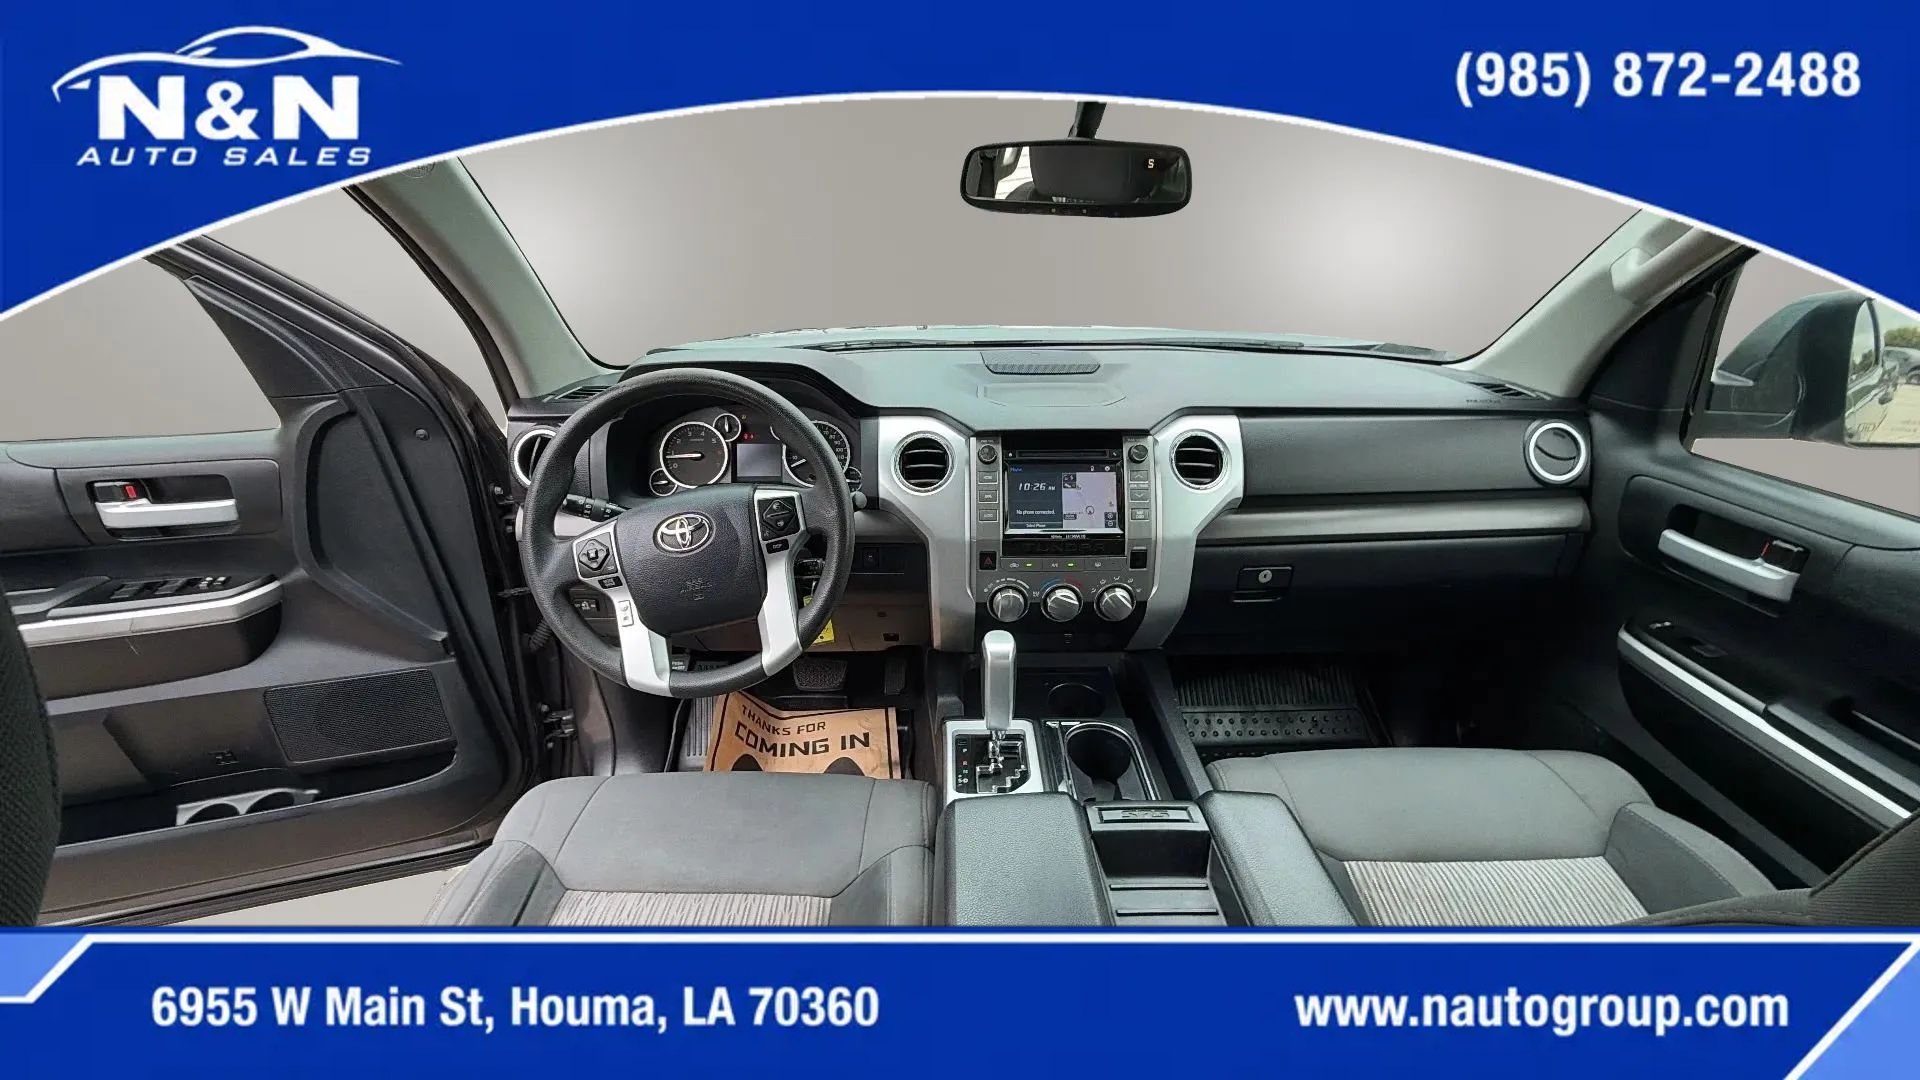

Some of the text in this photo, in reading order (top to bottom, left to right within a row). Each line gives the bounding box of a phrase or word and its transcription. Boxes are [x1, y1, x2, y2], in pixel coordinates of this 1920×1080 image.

[1147, 158, 1155, 169] S
[1018, 482, 1047, 491] 10:26
[741, 704, 827, 736] THANKS FOR
[734, 720, 870, 758] COMING IN
